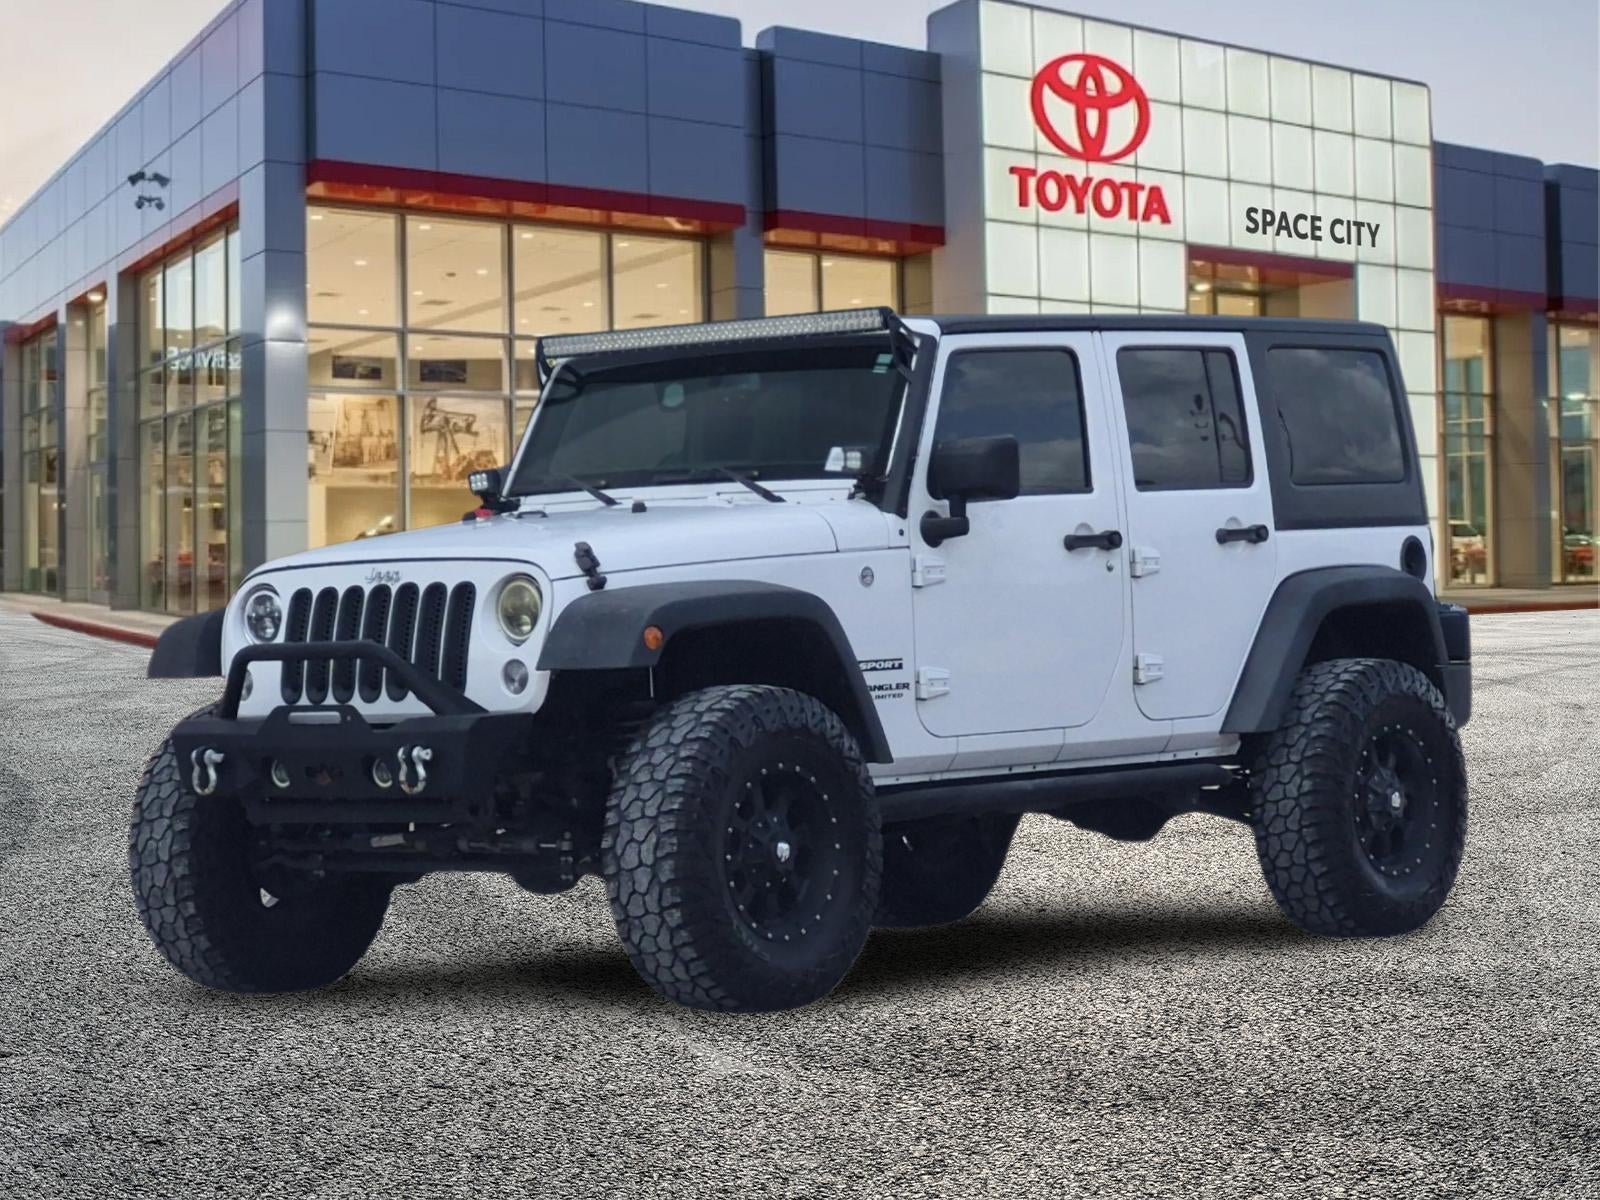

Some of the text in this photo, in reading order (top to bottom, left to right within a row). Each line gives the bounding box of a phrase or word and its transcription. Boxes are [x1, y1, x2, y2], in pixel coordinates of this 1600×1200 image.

[1009, 166, 1171, 225] TOYOTA
[1245, 206, 1381, 248] SPACE CITY
[858, 660, 902, 671] SPORT
[866, 682, 910, 692] ANGLER
